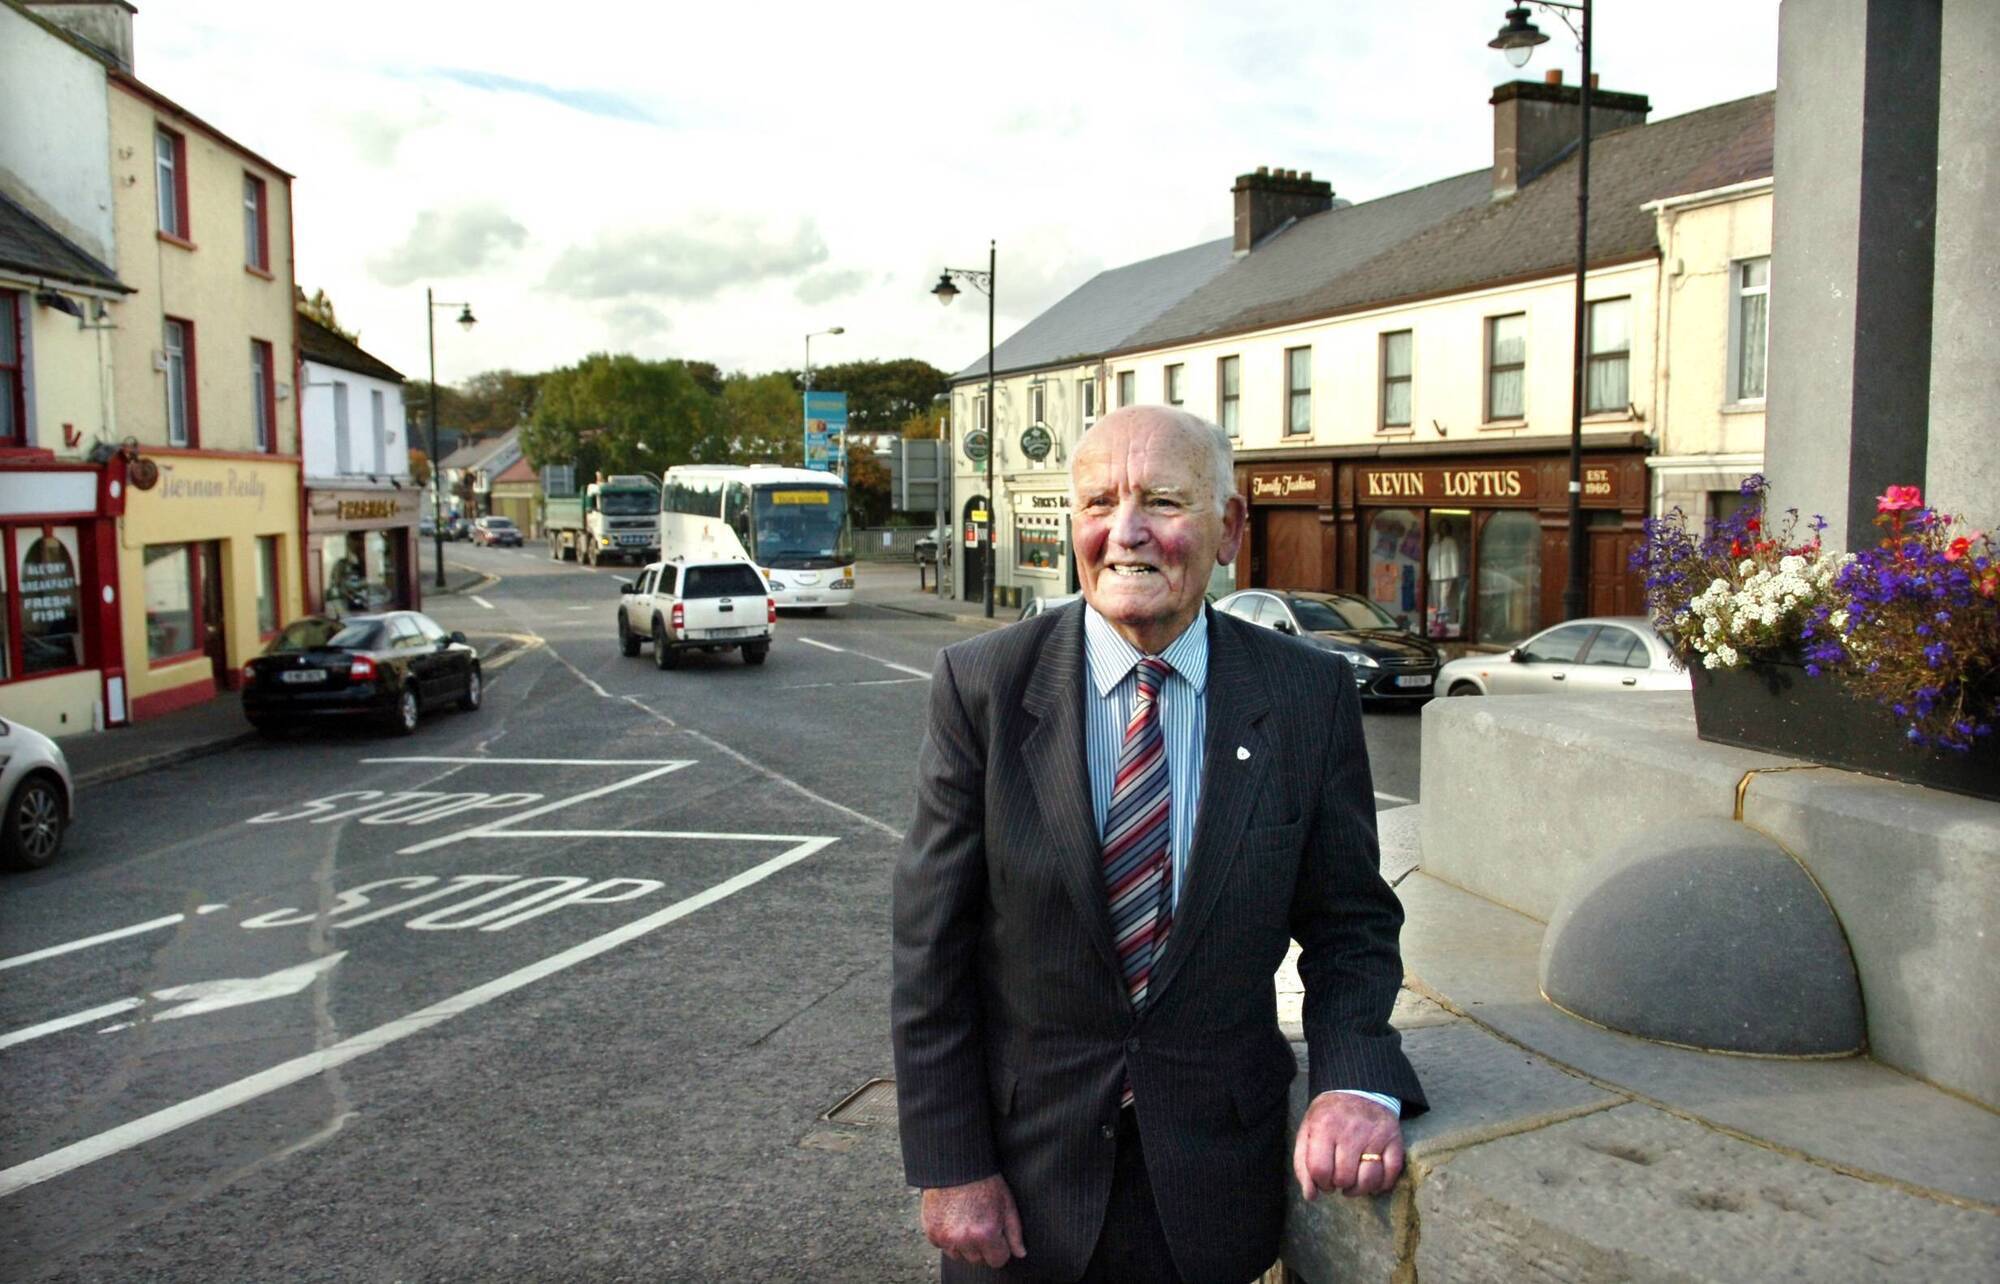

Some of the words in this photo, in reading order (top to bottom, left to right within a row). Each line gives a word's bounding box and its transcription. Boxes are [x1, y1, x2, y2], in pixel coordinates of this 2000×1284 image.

[1368, 472, 1424, 496] KEVIN
[1443, 471, 1521, 496] LOFTUS
[24, 595, 72, 610] FRESH
[32, 608, 66, 623] FISH
[246, 790, 545, 826] STOP
[239, 874, 666, 932] STOP
